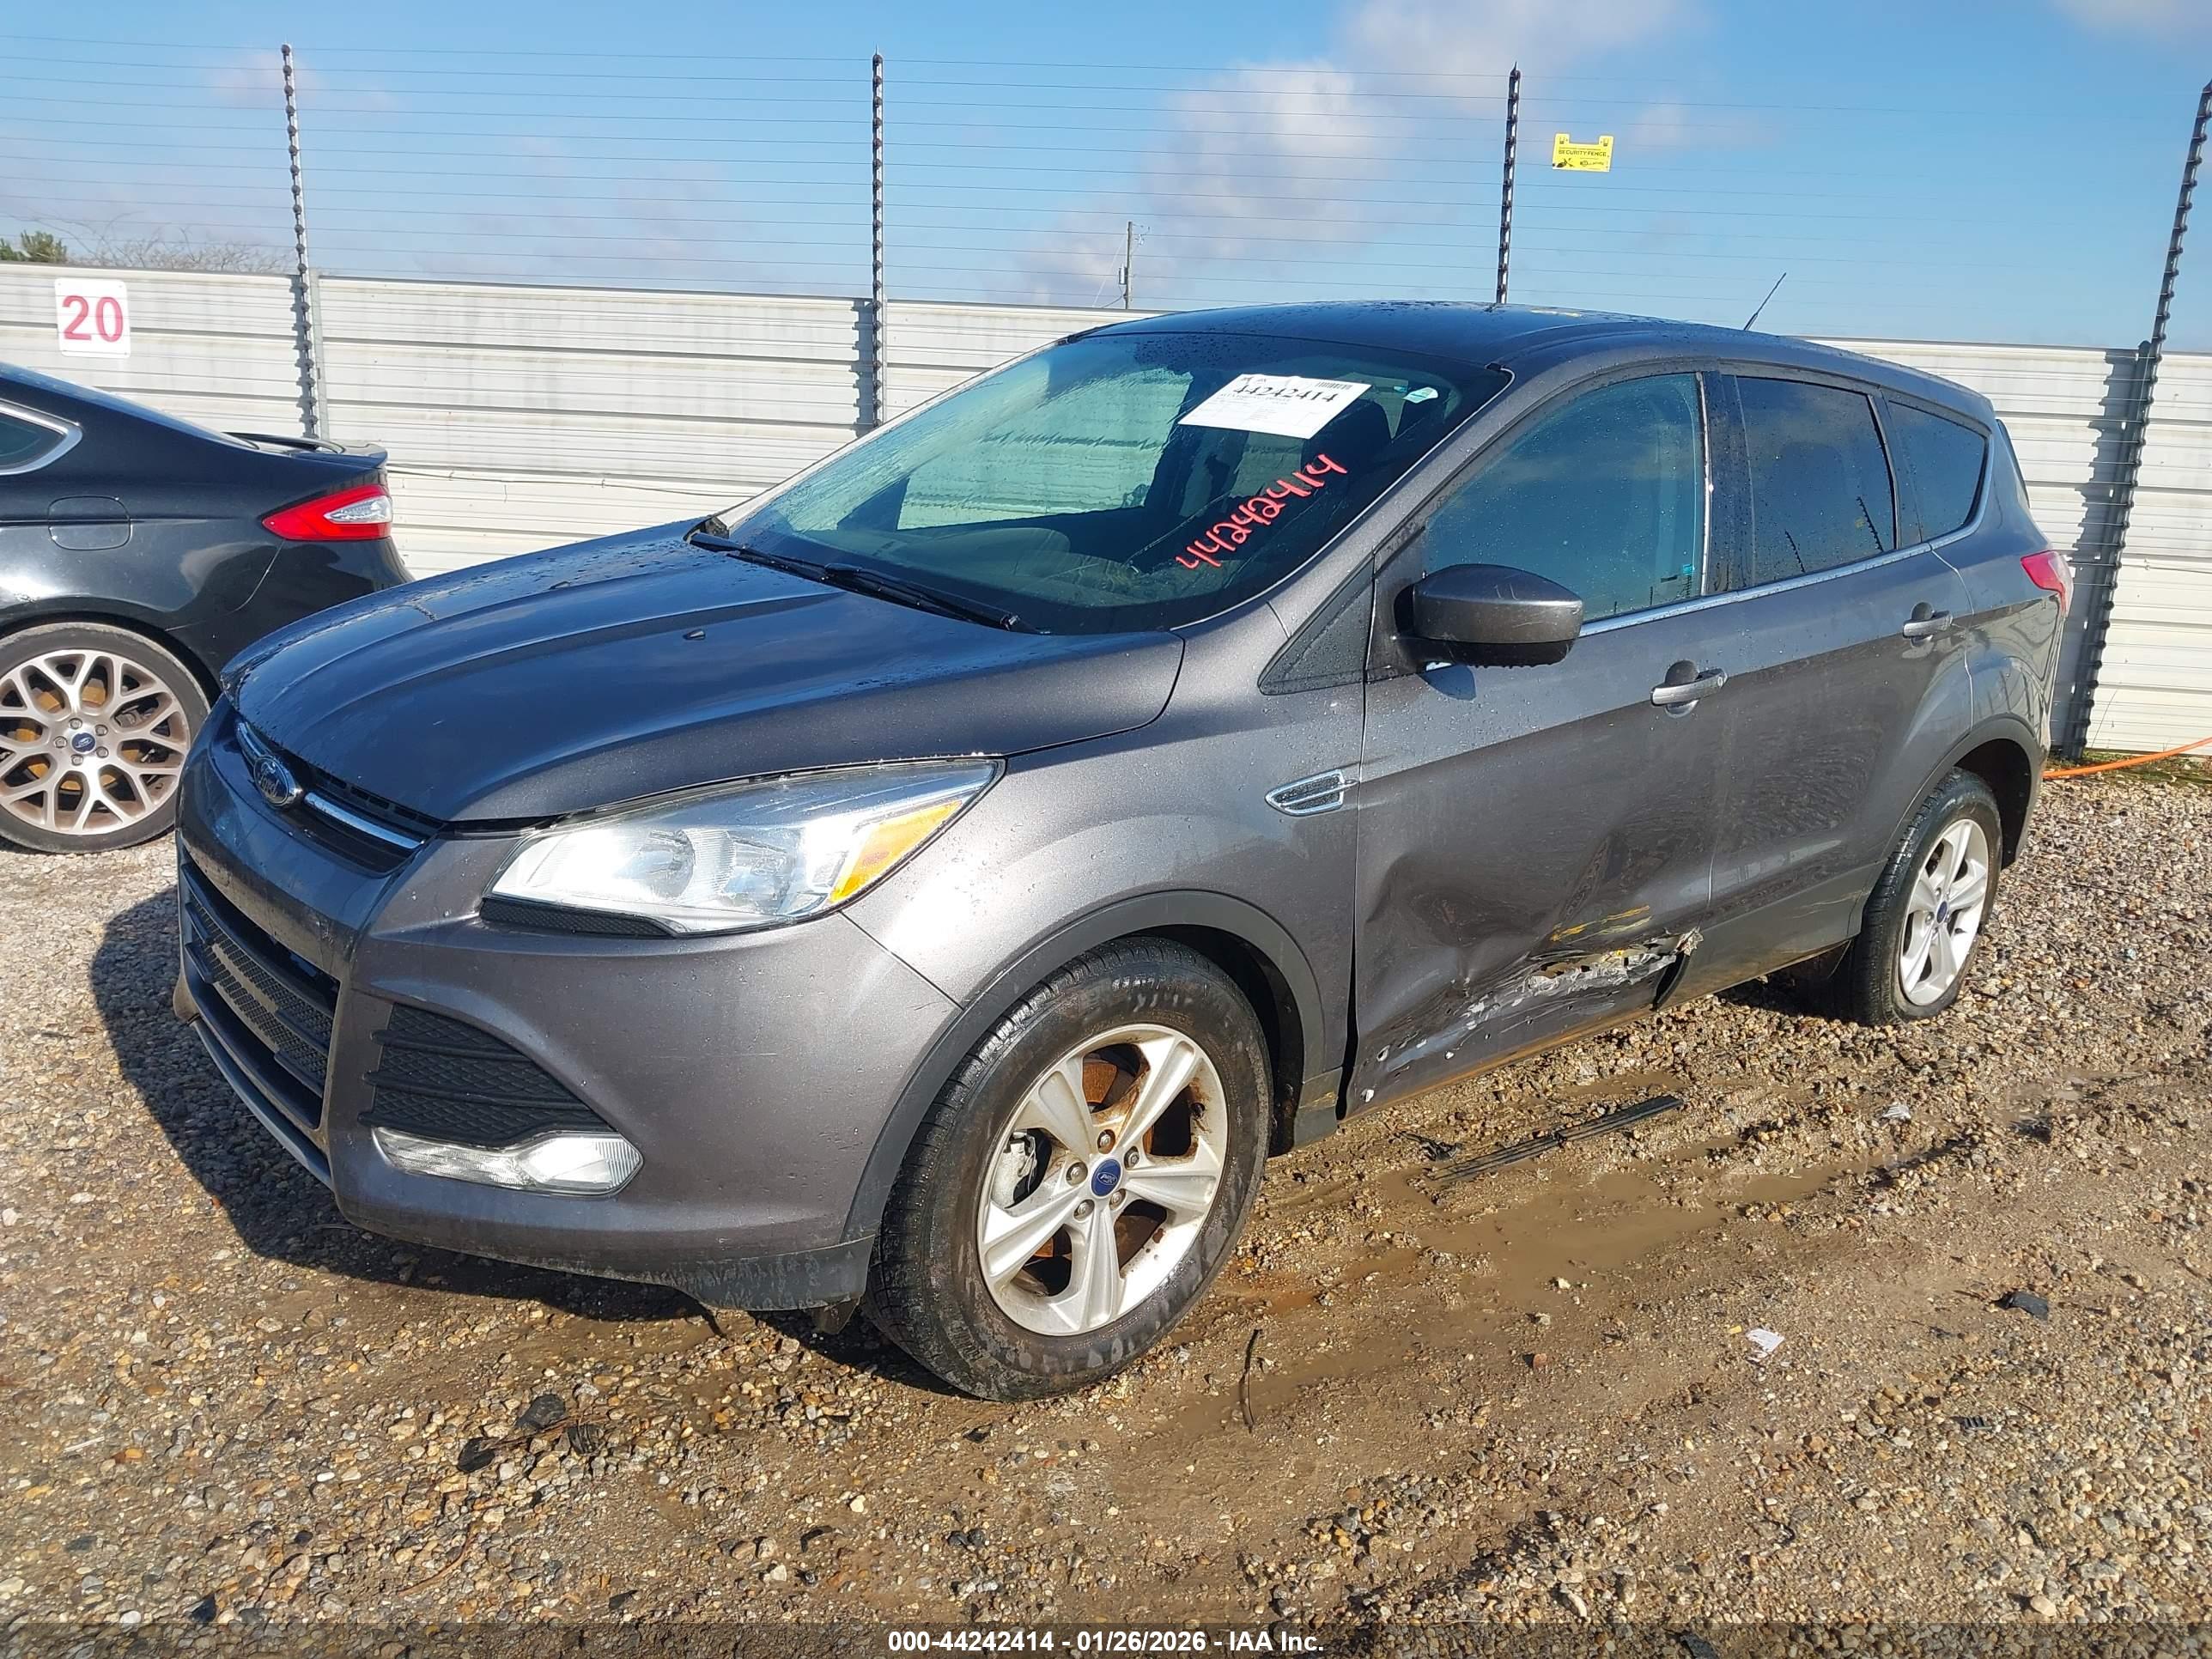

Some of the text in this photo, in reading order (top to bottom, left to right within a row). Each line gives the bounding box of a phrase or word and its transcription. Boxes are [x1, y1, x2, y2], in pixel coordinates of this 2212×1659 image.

[62, 295, 124, 343] 20
[1233, 384, 1339, 403] 44242414
[1176, 453, 1347, 568] 44242414
